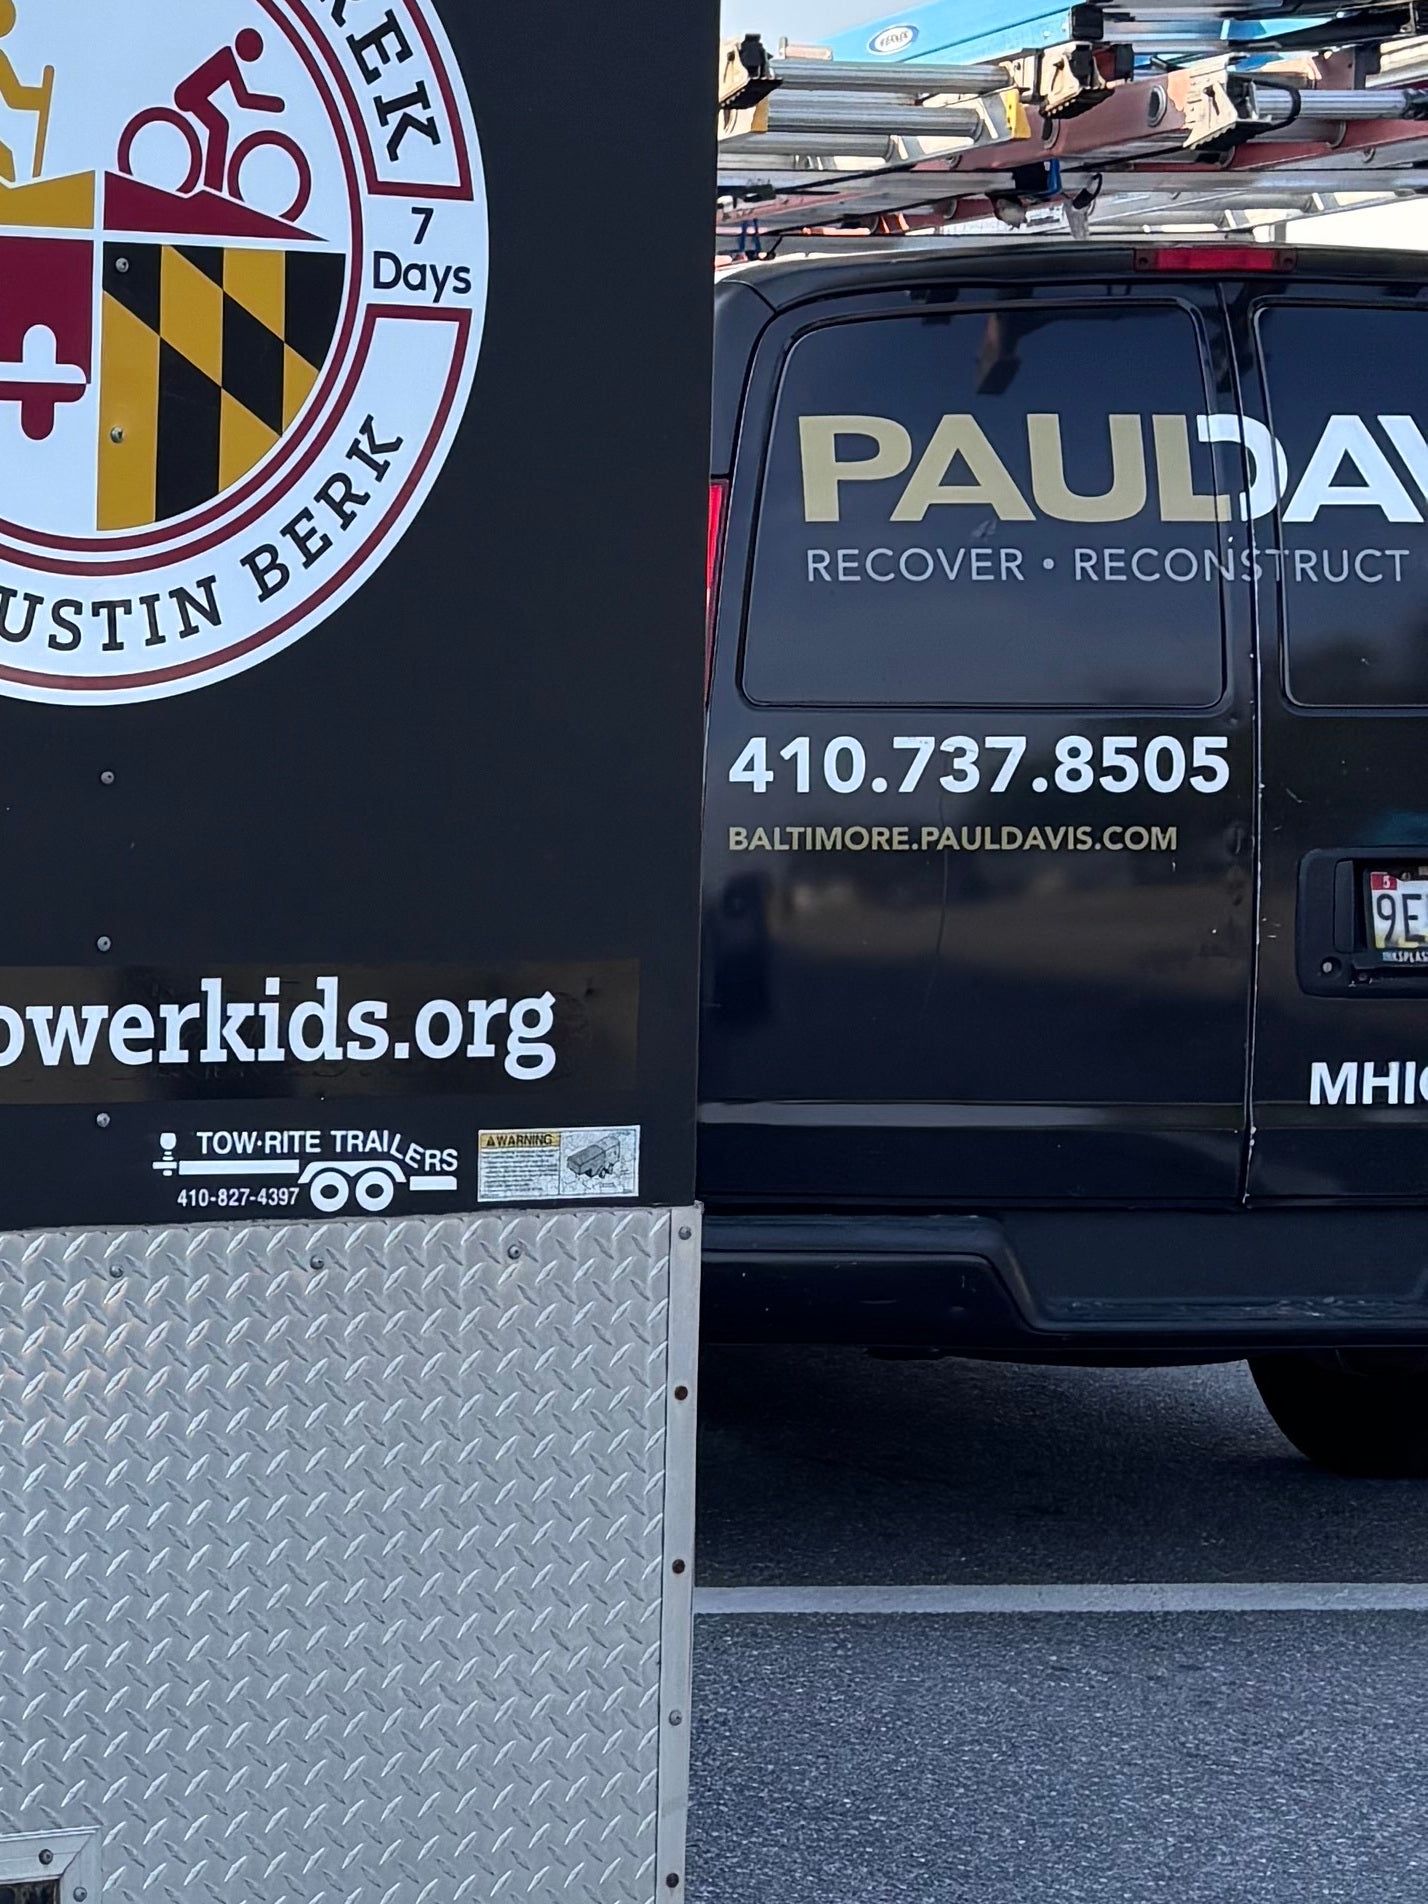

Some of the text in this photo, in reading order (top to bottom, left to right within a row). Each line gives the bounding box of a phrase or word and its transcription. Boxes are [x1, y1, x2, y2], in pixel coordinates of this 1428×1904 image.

[410, 207, 434, 246] 7
[373, 250, 472, 303] Days
[240, 413, 403, 604] BERK
[806, 546, 1411, 584] RECOVER RECONSTRUCT
[728, 734, 1232, 794] 410.737.8505
[728, 825, 1178, 852] BALTIMORE.PAULDAVIS.COM
[1376, 893, 1428, 943] 9E
[1308, 1060, 1428, 1106] MHI
[330, 1130, 459, 1172] TRAILERS
[496, 1133, 553, 1147] WARNING
[177, 1186, 300, 1207] 410-827-4397
